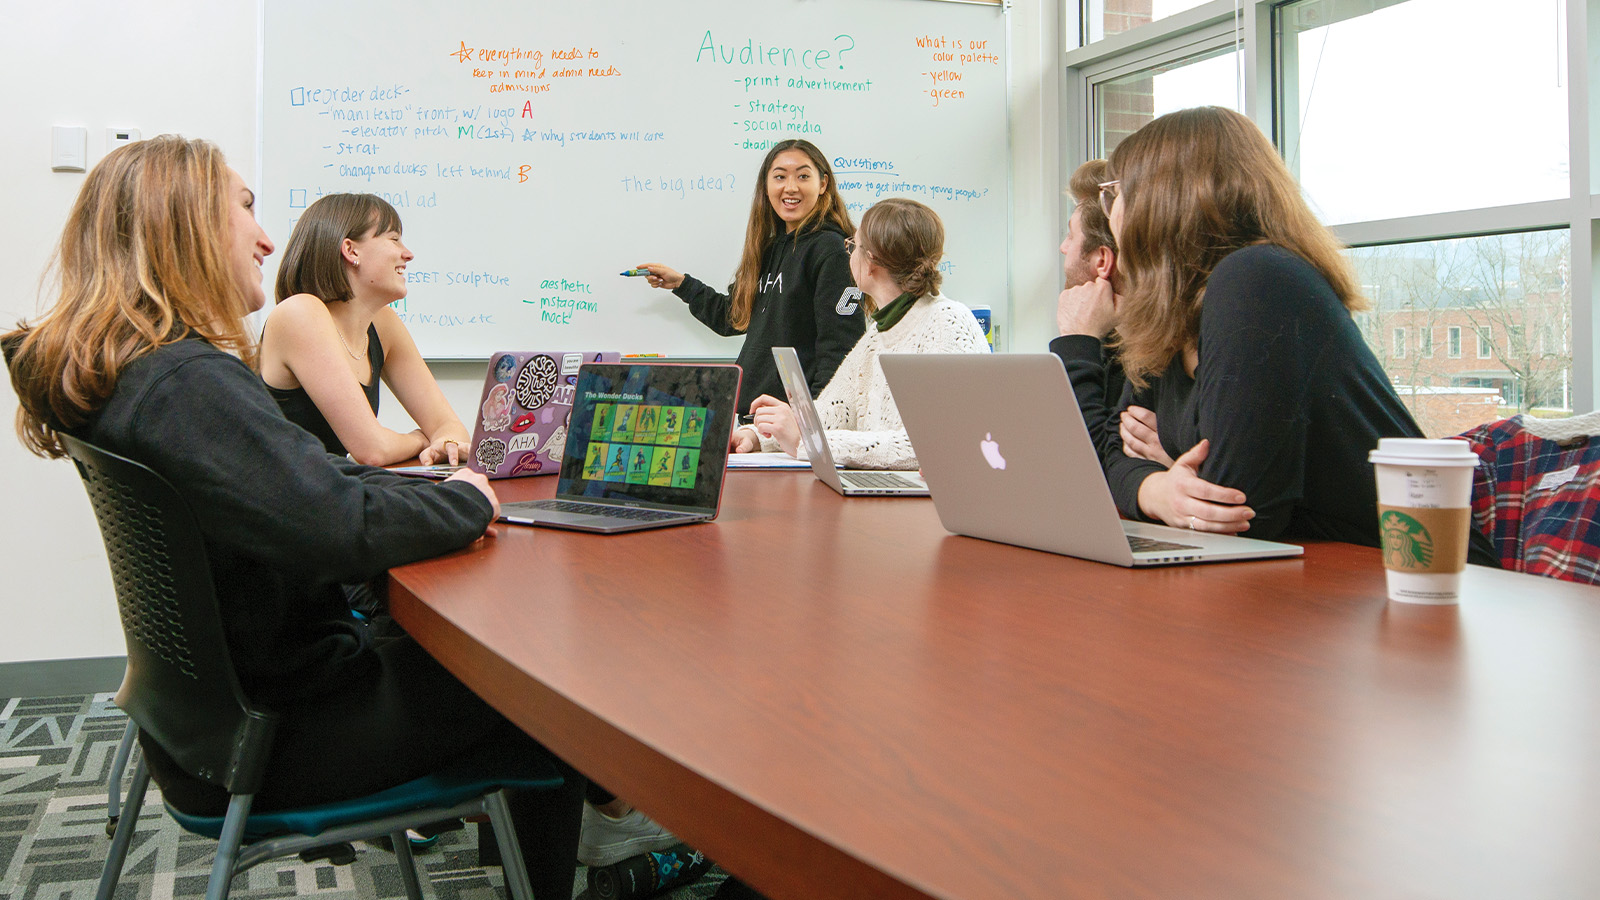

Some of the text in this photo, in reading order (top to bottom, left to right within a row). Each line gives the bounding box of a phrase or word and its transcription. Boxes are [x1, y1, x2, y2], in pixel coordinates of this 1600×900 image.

[697, 30, 855, 70] Audience?
[952, 40, 962, 49] is
[970, 40, 987, 49] our
[478, 48, 599, 69] everything needs to
[933, 52, 998, 66] color palette
[500, 69, 510, 77] in
[515, 67, 545, 78] mind
[552, 66, 583, 77] admin
[588, 65, 622, 76] needs
[930, 70, 962, 85] yellow
[490, 82, 550, 93] admissions
[745, 75, 872, 92] print advertisement
[306, 86, 364, 105] reorder
[931, 88, 965, 107] green
[522, 100, 533, 119] A
[351, 125, 408, 137] elevator
[414, 126, 449, 139] pitch
[458, 125, 474, 139] M
[570, 131, 616, 141] students
[620, 131, 639, 141] will
[644, 131, 664, 141] care
[744, 120, 822, 135] social media
[834, 156, 894, 170] Questions
[437, 163, 463, 178] left
[470, 165, 510, 180] behind
[518, 165, 532, 183] B
[659, 176, 685, 200] big
[690, 174, 736, 193] idea?
[866, 180, 874, 192] to
[876, 181, 889, 197] get
[929, 185, 952, 200] young
[417, 192, 437, 208] ad
[408, 271, 439, 283] ESET
[540, 278, 592, 294] aesthetic
[835, 286, 863, 315] C
[585, 391, 597, 399] The
[598, 392, 622, 400] Wonder
